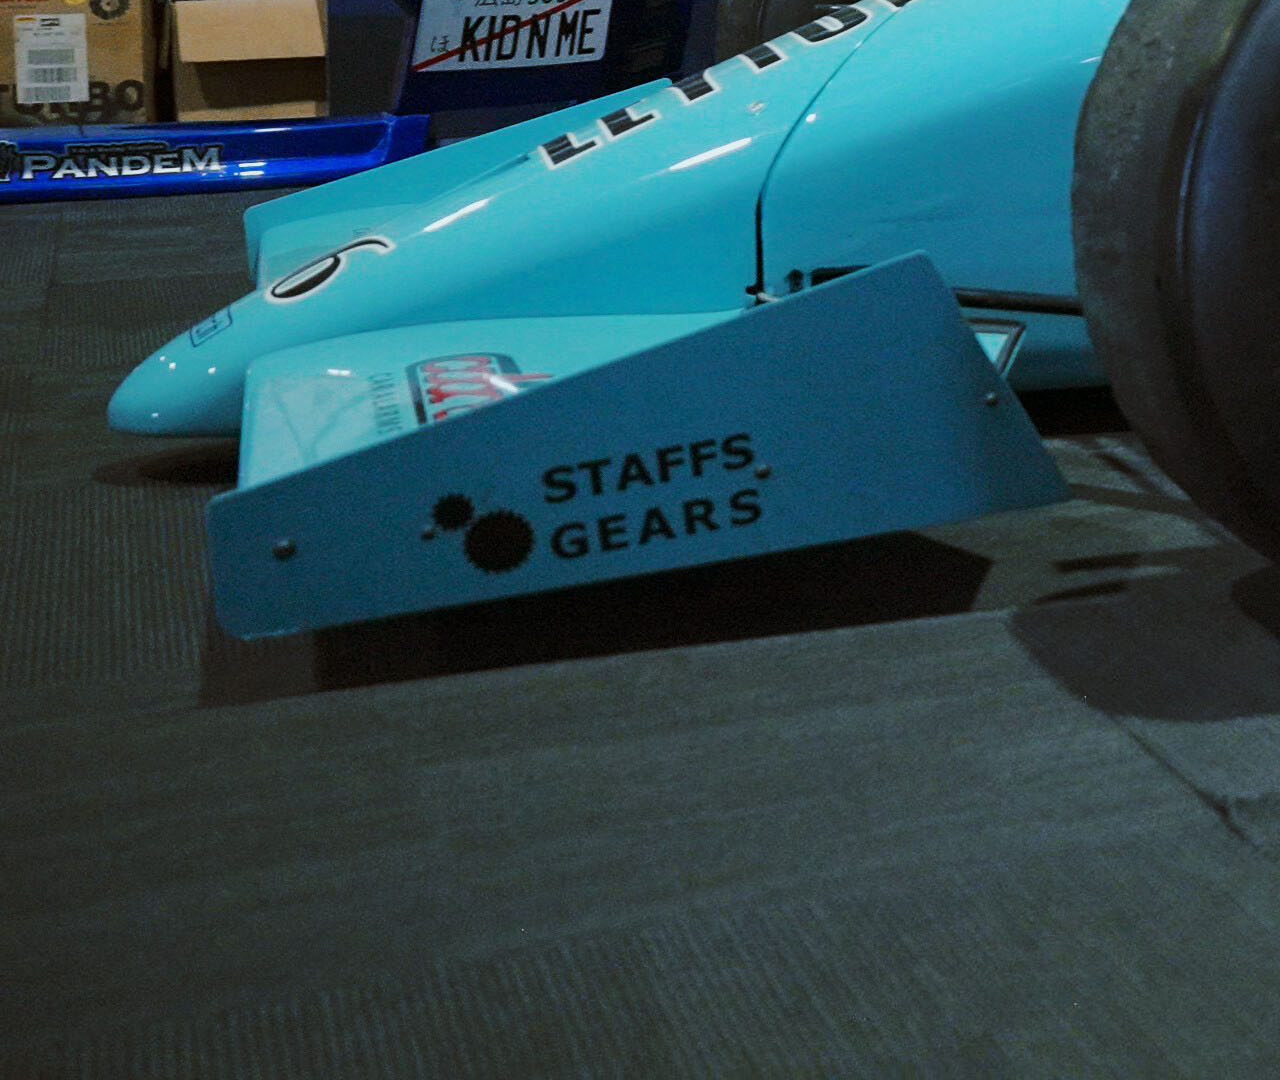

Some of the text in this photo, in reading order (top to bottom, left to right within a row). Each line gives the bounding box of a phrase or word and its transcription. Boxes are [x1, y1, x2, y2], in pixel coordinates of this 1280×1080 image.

[21, 145, 223, 180] PANDEM
[539, 432, 757, 505] STAFFS
[549, 488, 765, 562] GEARS
